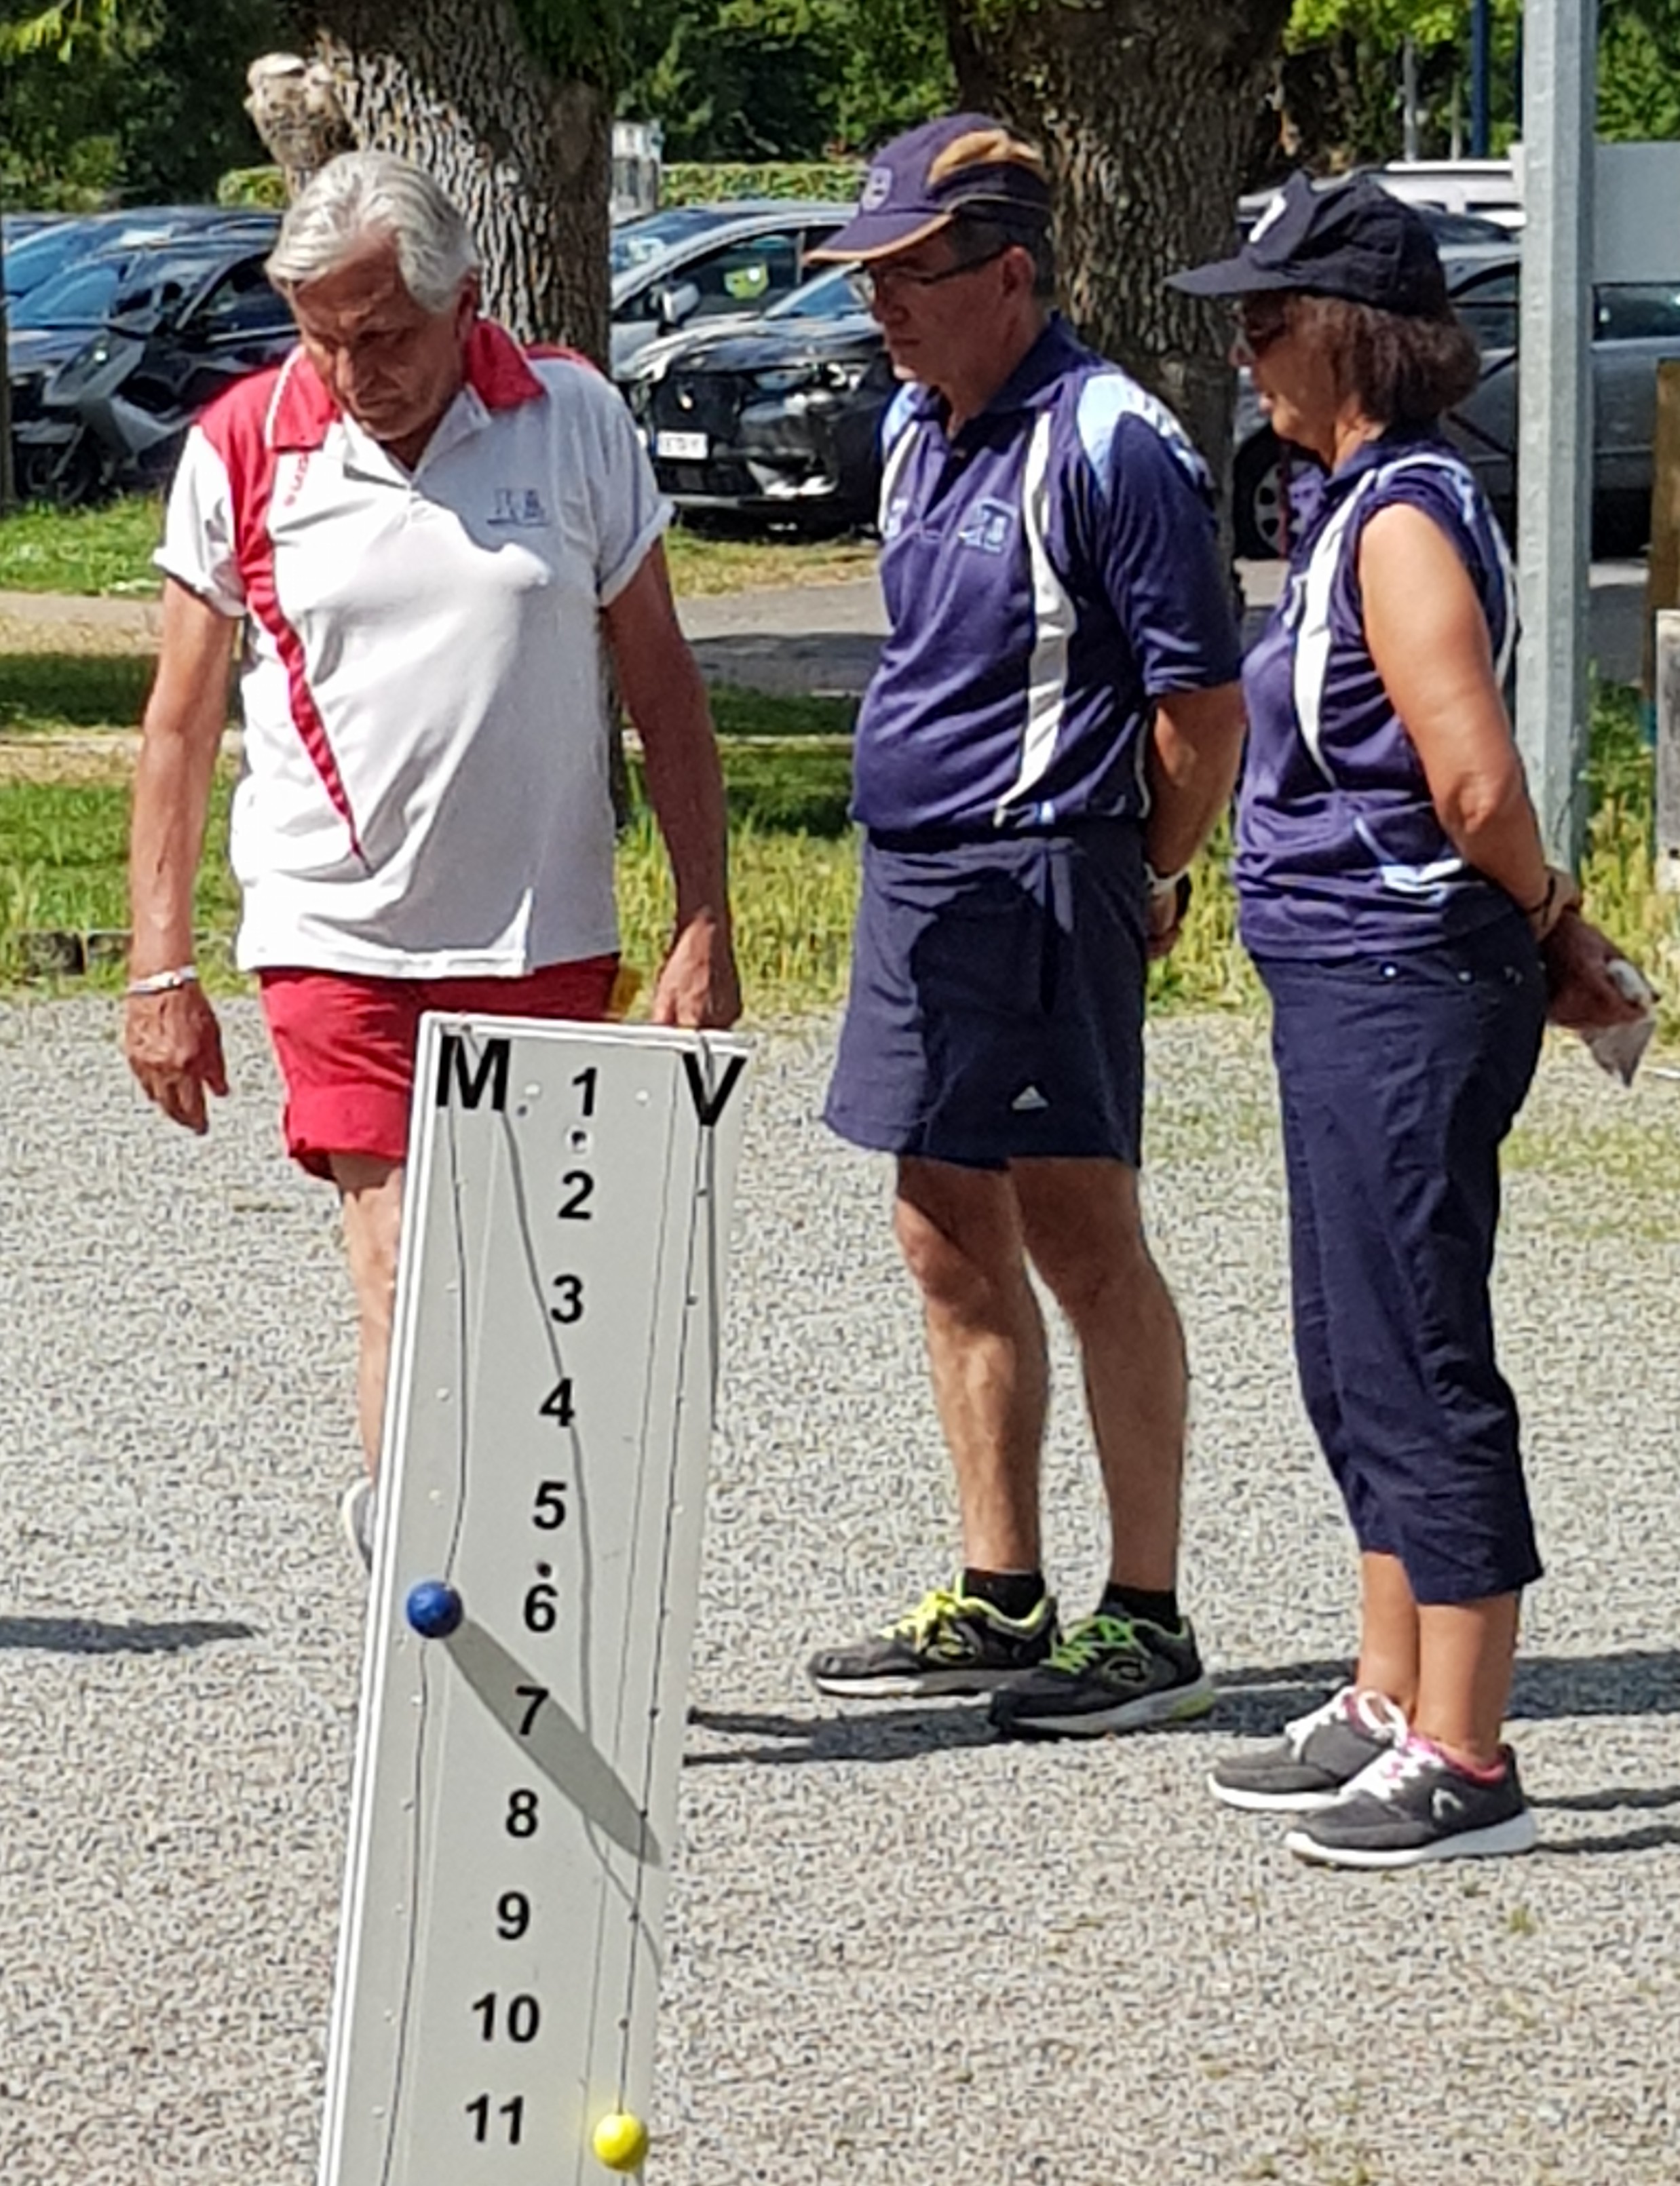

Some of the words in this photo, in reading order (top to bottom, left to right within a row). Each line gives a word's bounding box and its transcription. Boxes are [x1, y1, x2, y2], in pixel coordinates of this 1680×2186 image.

[436, 1035, 511, 1113] M
[572, 1067, 597, 1117] 1
[682, 1052, 748, 1127] V
[558, 1170, 594, 1220] 2
[550, 1274, 584, 1324] 3
[539, 1377, 575, 1427] 4
[532, 1480, 567, 1530] 5
[524, 1584, 558, 1633] 6
[515, 1685, 550, 1736] 7
[505, 1789, 538, 1838] 8
[497, 1891, 530, 1940] 9
[472, 1992, 539, 2044] 10
[465, 2094, 523, 2145] 11
